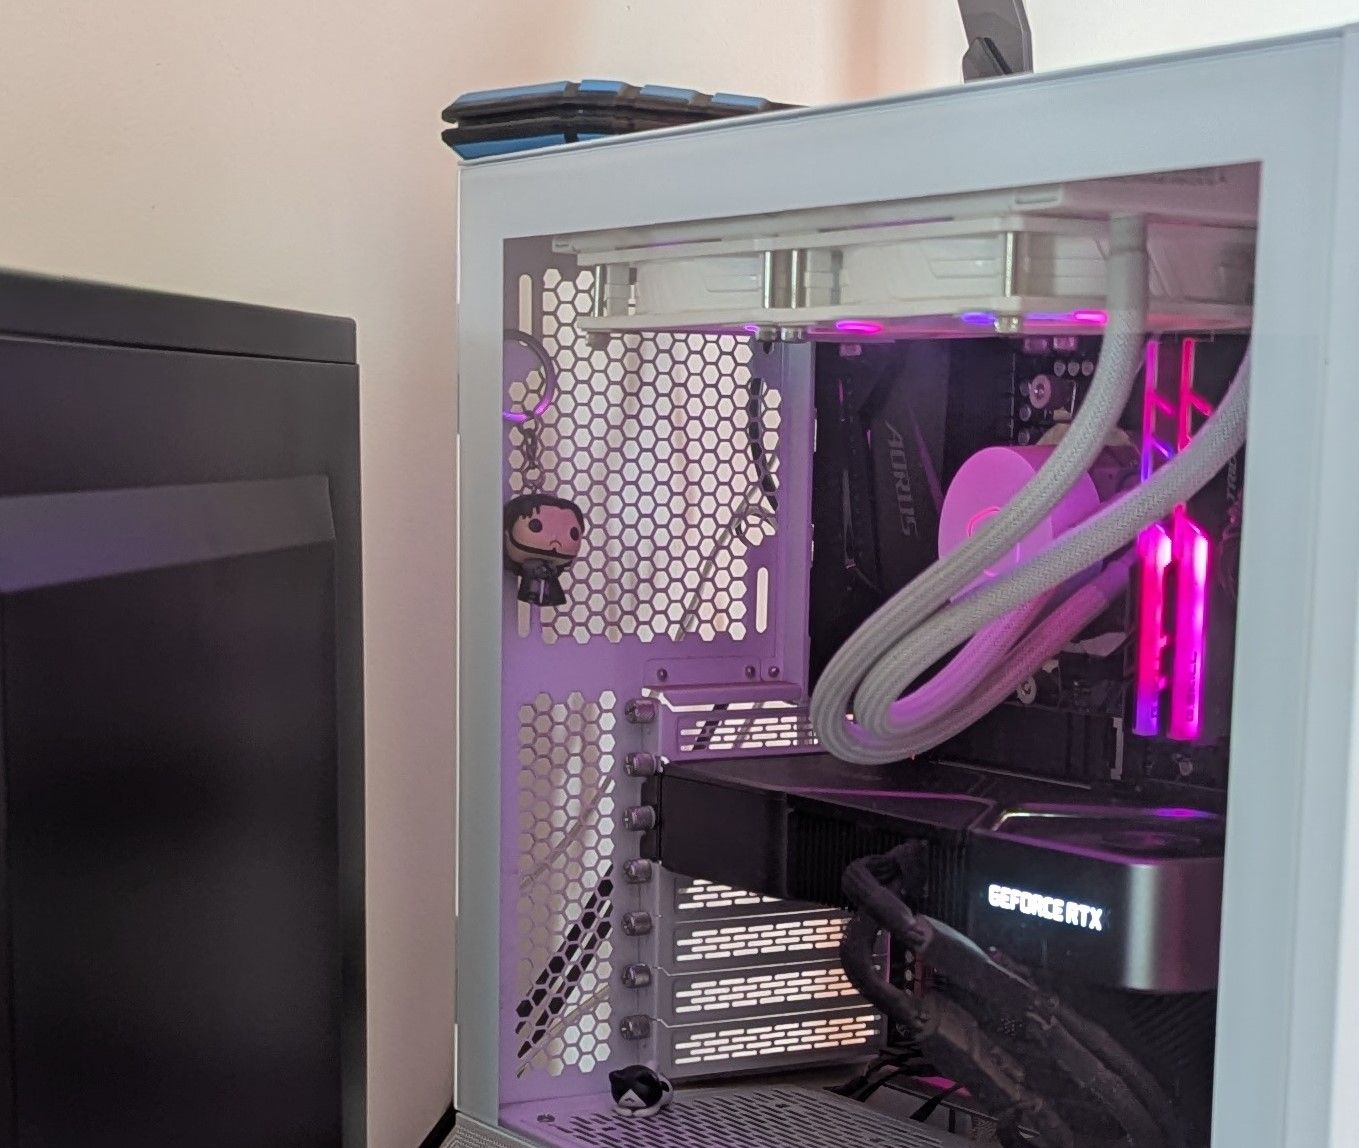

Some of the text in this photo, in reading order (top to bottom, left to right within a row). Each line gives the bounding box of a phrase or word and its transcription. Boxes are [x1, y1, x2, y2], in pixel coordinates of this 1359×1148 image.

[885, 419, 919, 537] AORUS
[988, 884, 1103, 931] GEFORCE RTX
